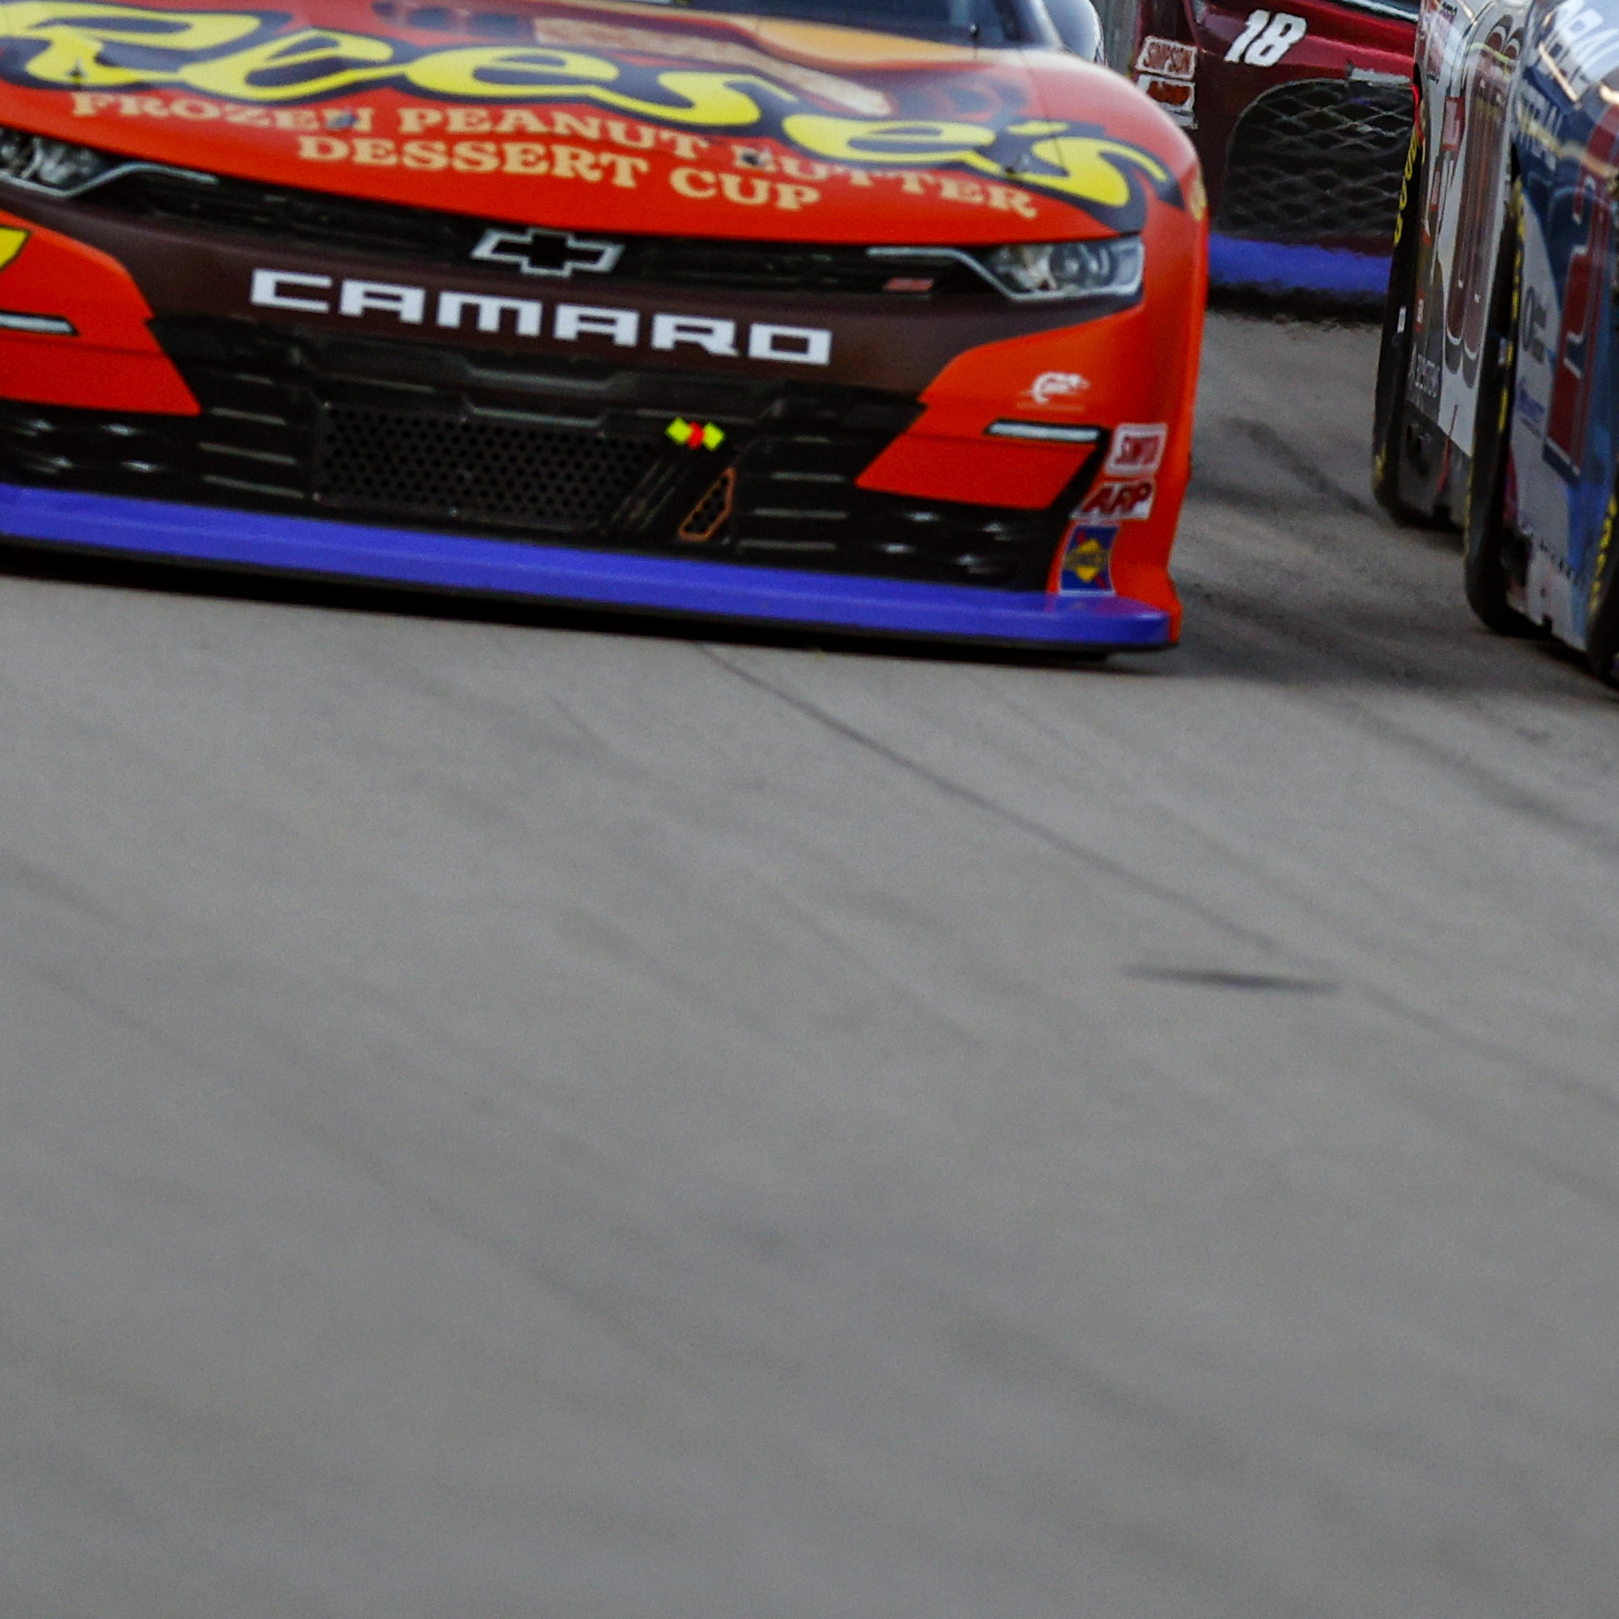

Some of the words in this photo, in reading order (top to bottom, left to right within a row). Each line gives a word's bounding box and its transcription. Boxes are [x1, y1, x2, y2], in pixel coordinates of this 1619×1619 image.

[1223, 8, 1307, 68] 18
[70, 91, 375, 135] FROZEN
[397, 107, 708, 159] PEANUT
[298, 134, 649, 189] DESSERT
[732, 145, 1039, 219] BUTTER
[669, 167, 822, 212] CUP
[250, 268, 833, 366] CAMARO
